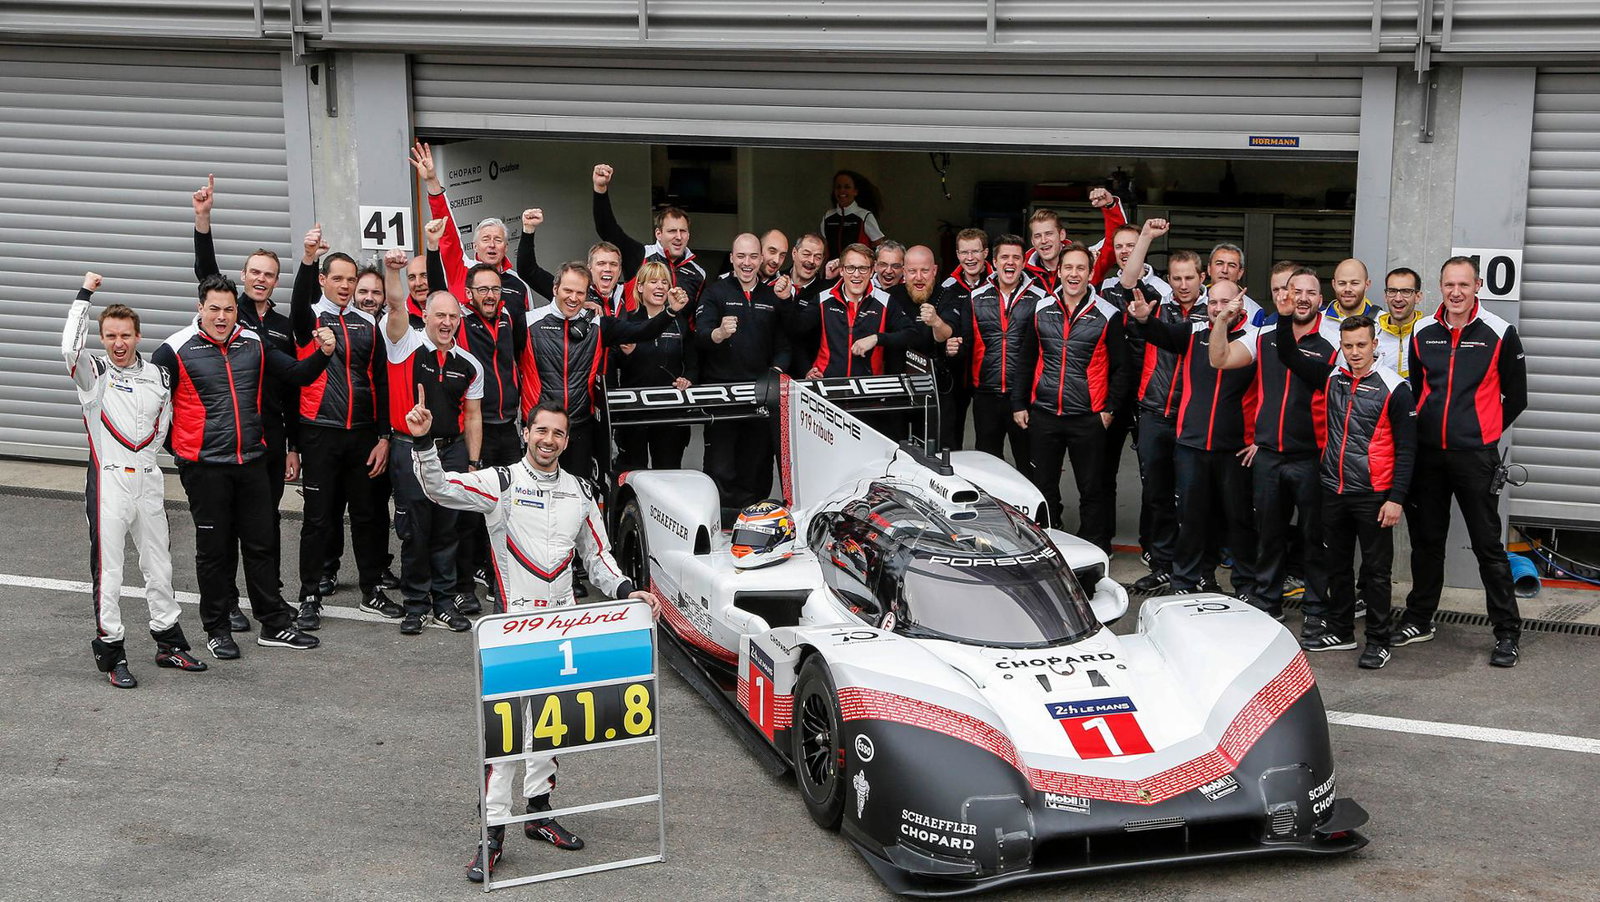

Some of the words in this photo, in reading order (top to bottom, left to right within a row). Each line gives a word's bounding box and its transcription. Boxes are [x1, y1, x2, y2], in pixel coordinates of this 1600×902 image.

[449, 166, 482, 179] CHOPARD
[450, 195, 483, 209] SCHAEFFLER
[363, 211, 405, 246] 41
[800, 392, 861, 441] PORSCHE
[800, 411, 812, 431] 919
[812, 419, 834, 446] tribute
[515, 486, 536, 496] Mobil
[650, 504, 689, 541] SCHAEFFLER
[928, 547, 1057, 567] PORSCHE
[503, 617, 544, 635] 919
[546, 606, 630, 636] hybrid
[558, 640, 578, 676] 1
[995, 653, 1116, 669] CHOPARD
[755, 676, 764, 727] 1
[1095, 702, 1130, 712] MANS
[857, 738, 872, 756] Esso
[1082, 717, 1124, 755] 1
[1045, 792, 1078, 805] Mobil
[1198, 777, 1227, 795] Mobil
[901, 809, 977, 835] SCHAEFFLER
[900, 824, 975, 850] CHOPARD
